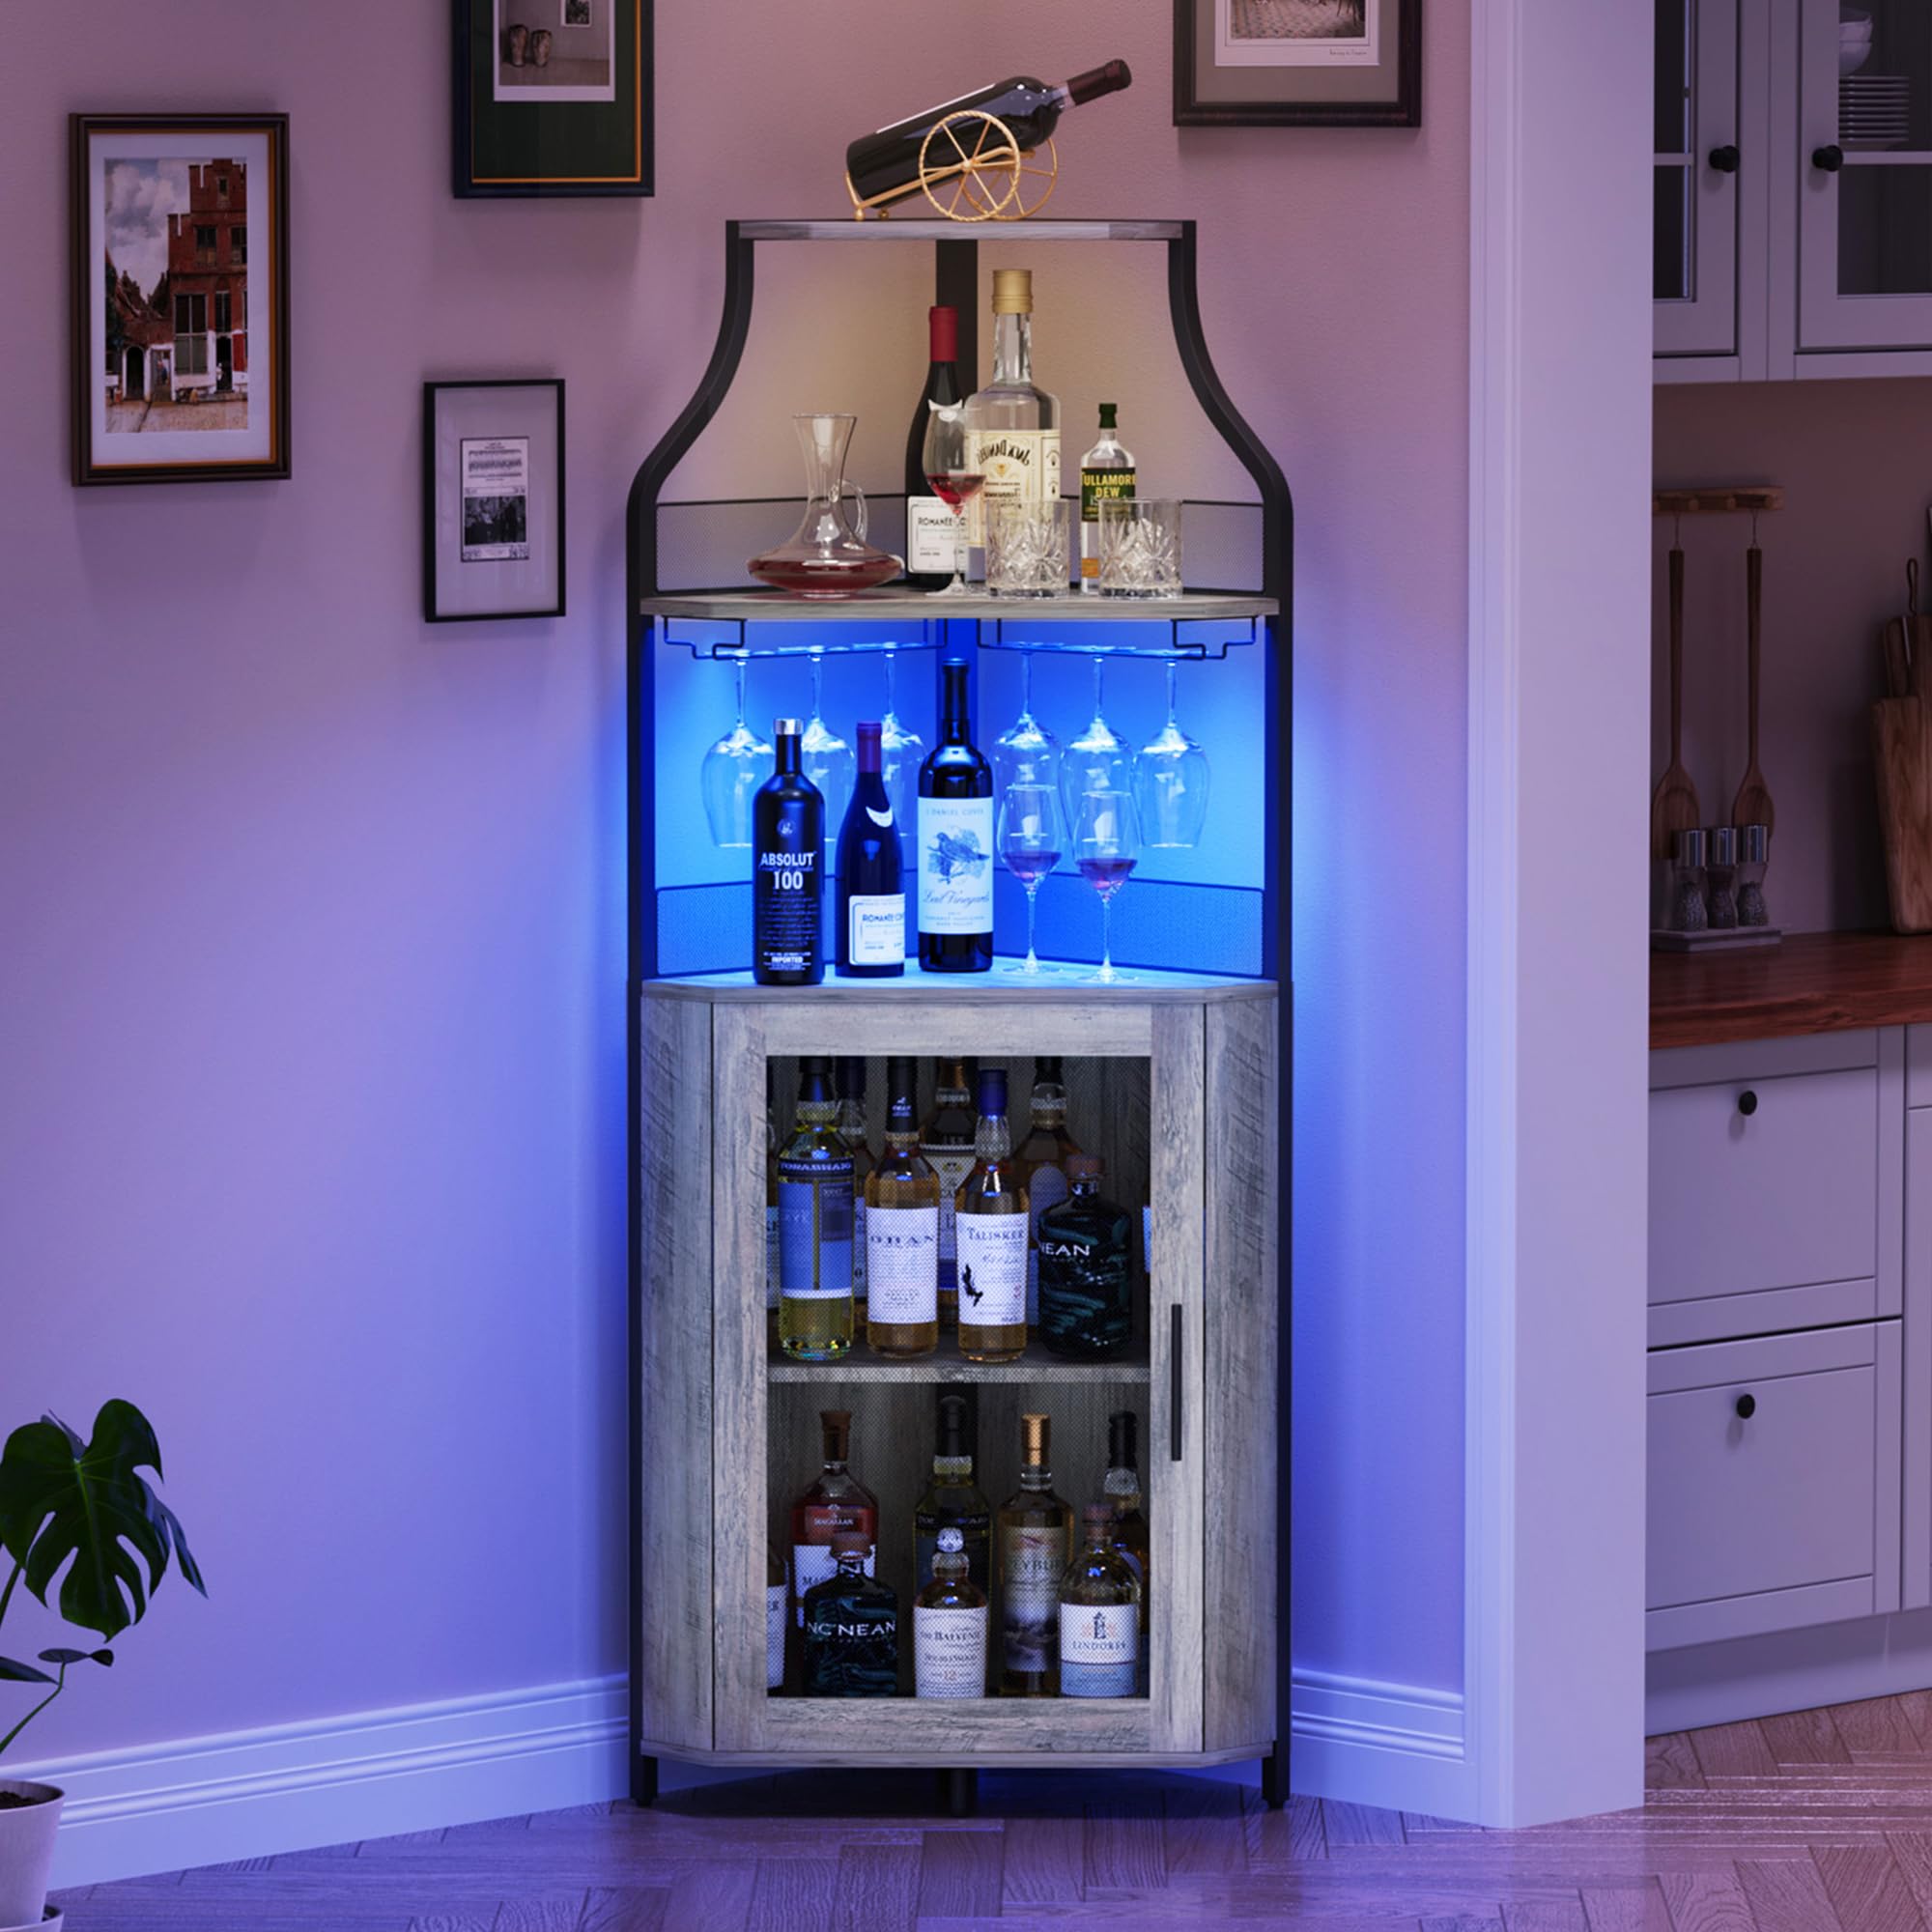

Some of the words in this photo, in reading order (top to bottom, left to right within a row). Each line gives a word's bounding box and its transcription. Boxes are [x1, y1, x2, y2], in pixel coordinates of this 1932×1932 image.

[1095, 486, 1121, 498] DEW
[759, 852, 814, 867] ABSOLUT
[774, 870, 804, 890] 100
